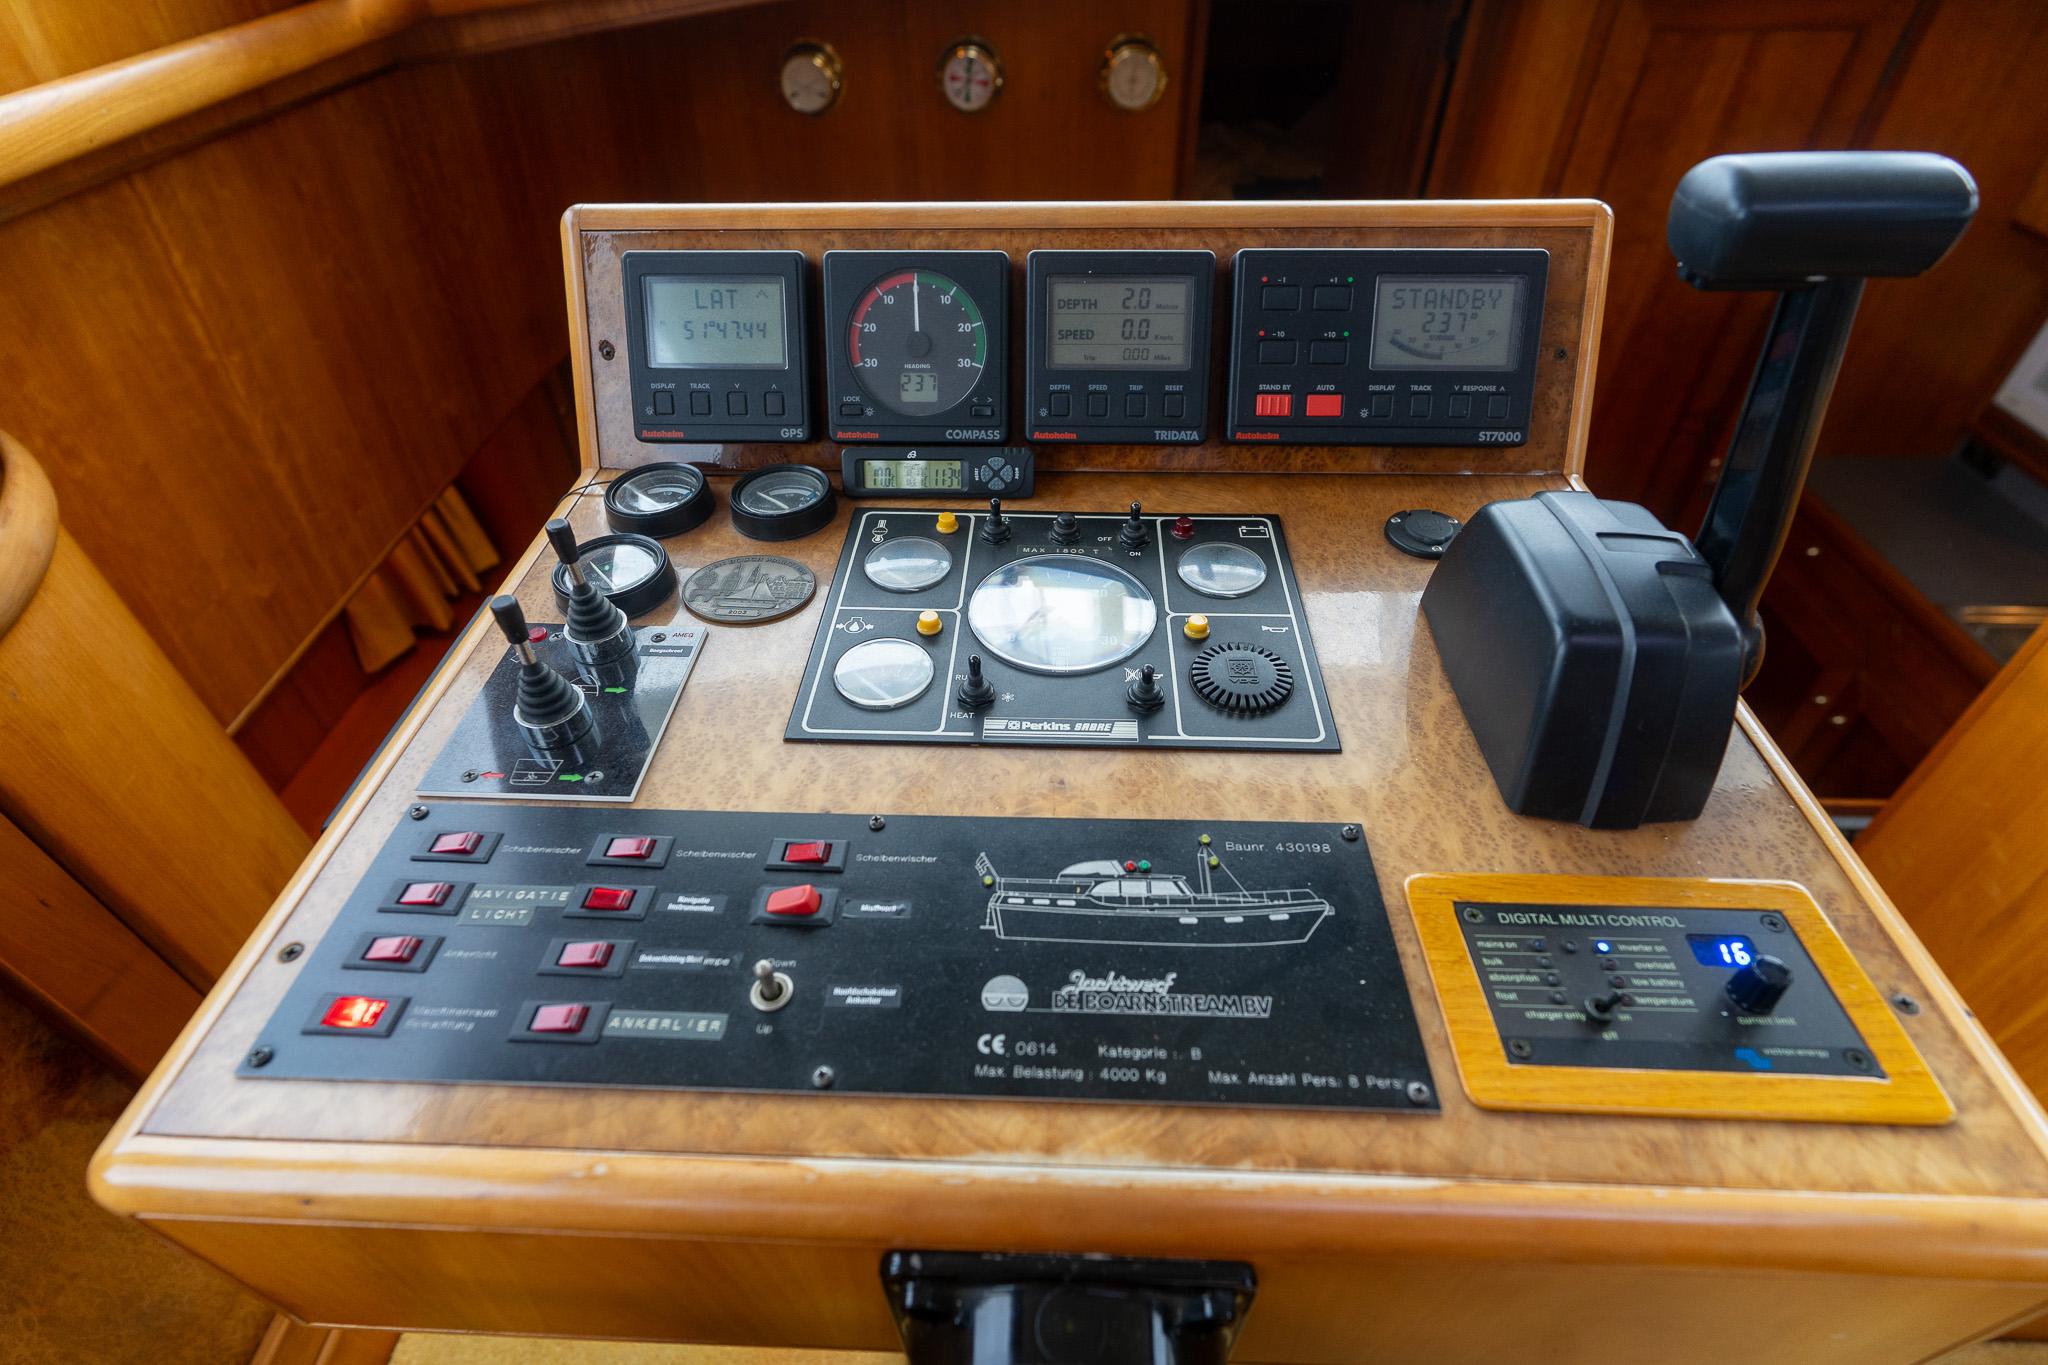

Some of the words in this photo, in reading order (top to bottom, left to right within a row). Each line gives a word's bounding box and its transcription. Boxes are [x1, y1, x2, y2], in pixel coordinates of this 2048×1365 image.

[695, 289, 737, 309] LAT
[883, 295, 894, 305] 10
[940, 295, 951, 305] 10
[1122, 287, 1151, 310] 2.0
[1392, 288, 1503, 309] STANDBY
[1057, 299, 1098, 310] DEPTH
[863, 323, 877, 332] 20
[957, 323, 972, 332] 20
[1121, 318, 1151, 340] 0.0
[1057, 329, 1095, 340] SPEED
[864, 358, 878, 367] 30
[957, 358, 971, 367] 30
[901, 375, 937, 392] 237
[642, 430, 684, 438] Autohelm
[780, 428, 804, 438] GPS
[837, 431, 879, 439] Autohelm
[946, 429, 1000, 440] COMPASS
[1033, 431, 1077, 440] Autohelm
[1154, 430, 1199, 441] TRIDATA
[1478, 431, 1522, 442] ST7000
[1228, 677, 1260, 685] VDO
[1021, 721, 1071, 732] Perkins
[1225, 841, 1268, 852] Baunr.
[1275, 843, 1332, 854] 430198
[675, 849, 757, 859] Scheibenwischer
[855, 854, 938, 864] Scheibenwischer
[470, 889, 571, 901] NAVIGATIE
[471, 909, 529, 920] LICHT
[1498, 912, 1558, 925] DIGITAL
[1559, 913, 1606, 926] MULTI
[1609, 915, 1685, 928] CONTROL
[1477, 941, 1504, 949] mains
[1719, 942, 1751, 966] 16
[1482, 957, 1504, 966] bulk
[1634, 961, 1677, 970] overload
[1489, 974, 1540, 983] absorption
[1650, 978, 1684, 989] battery
[1495, 992, 1519, 1001] float
[1052, 991, 1079, 1012] DE
[1083, 991, 1242, 1016] BOARNSTREAM
[608, 1016, 721, 1032] ANKERLIER
[977, 1033, 1006, 1055] CE
[1015, 1041, 1058, 1056] 0614
[1013, 1065, 1084, 1082] Belastung
[1099, 1068, 1140, 1082] 4000
[1146, 1070, 1167, 1085] Kg
[1248, 1071, 1296, 1087] Anzahl
